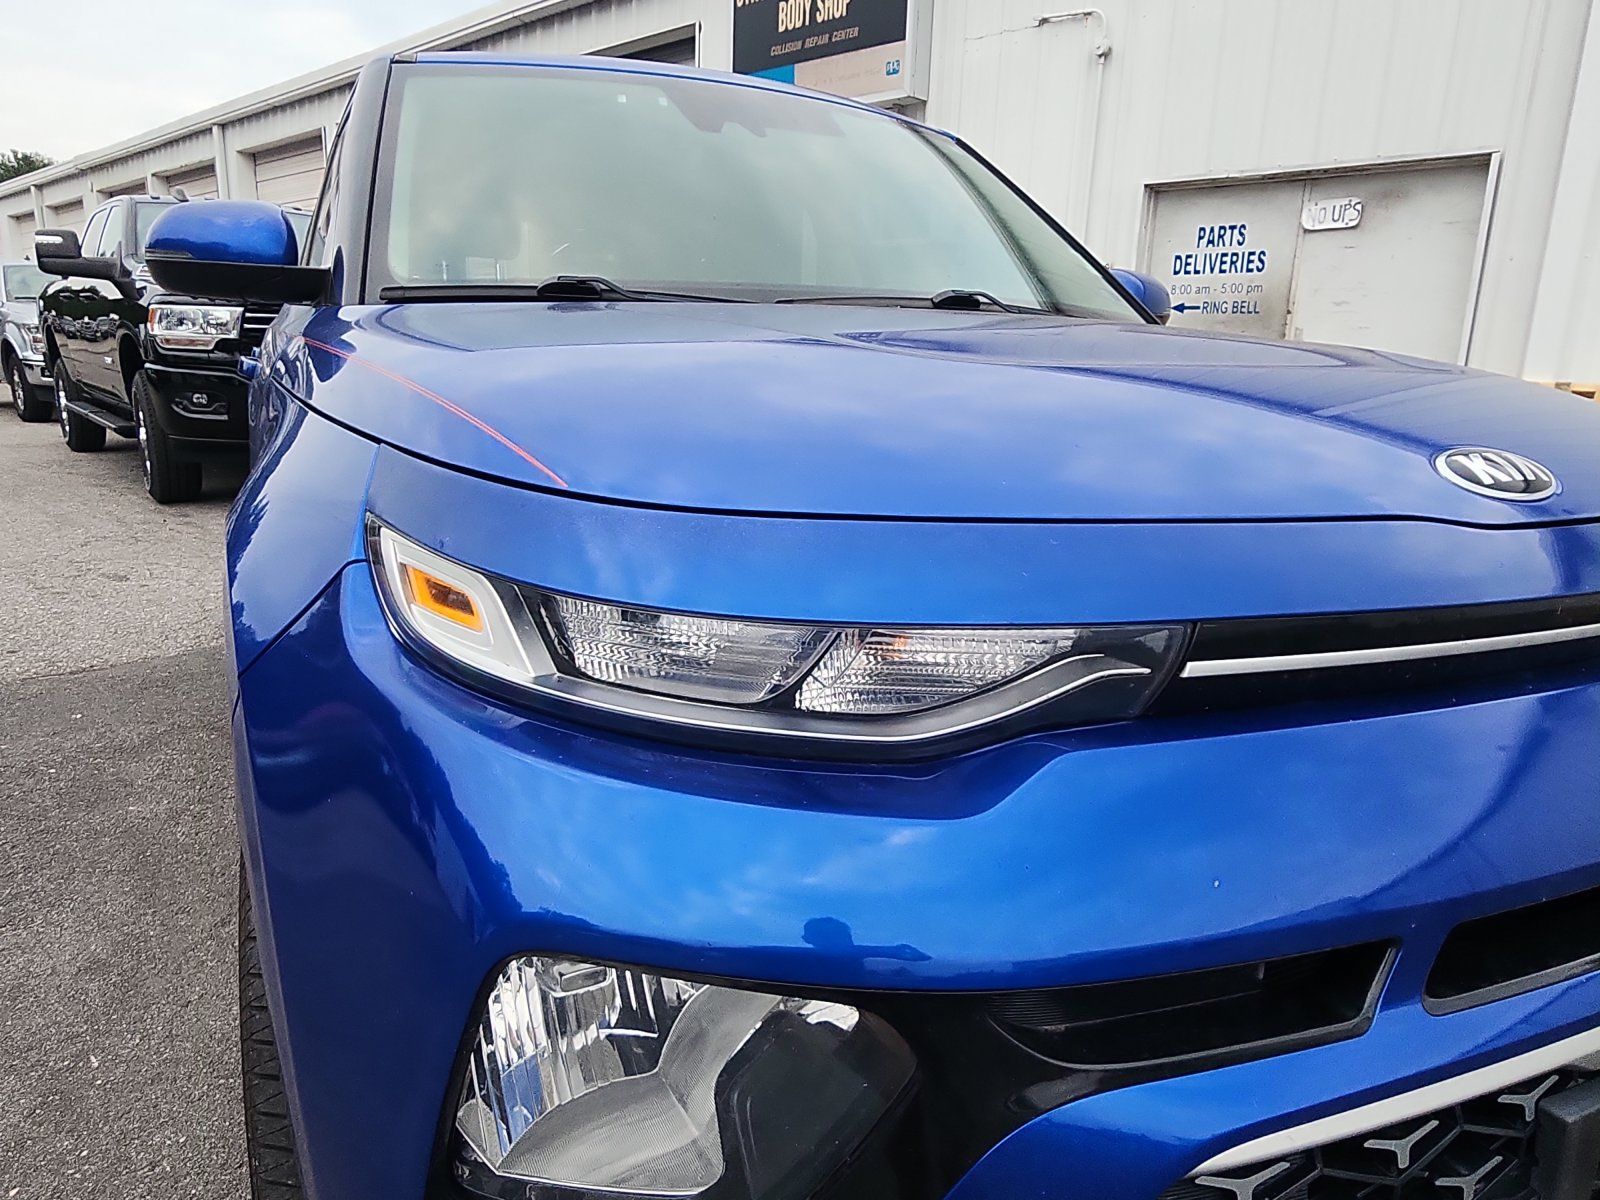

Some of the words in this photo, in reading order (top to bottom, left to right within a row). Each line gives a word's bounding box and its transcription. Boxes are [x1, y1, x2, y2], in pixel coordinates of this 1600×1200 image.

[778, 0, 812, 33] BODY
[816, 0, 850, 23] SHOP
[770, 40, 802, 56] COLLISION
[804, 33, 829, 49] REPAIR
[832, 26, 859, 42] CENTER
[1332, 201, 1362, 223] UPS
[1197, 224, 1247, 248] PARTS
[1172, 250, 1267, 275] DELIVERIES
[1170, 284, 1192, 295] 8:00
[1195, 286, 1210, 294] am
[1221, 283, 1243, 294] 5:00
[1246, 284, 1263, 295] pm
[1201, 301, 1228, 314] RING
[1231, 300, 1260, 314] BELL
[1443, 451, 1552, 487] KIA
